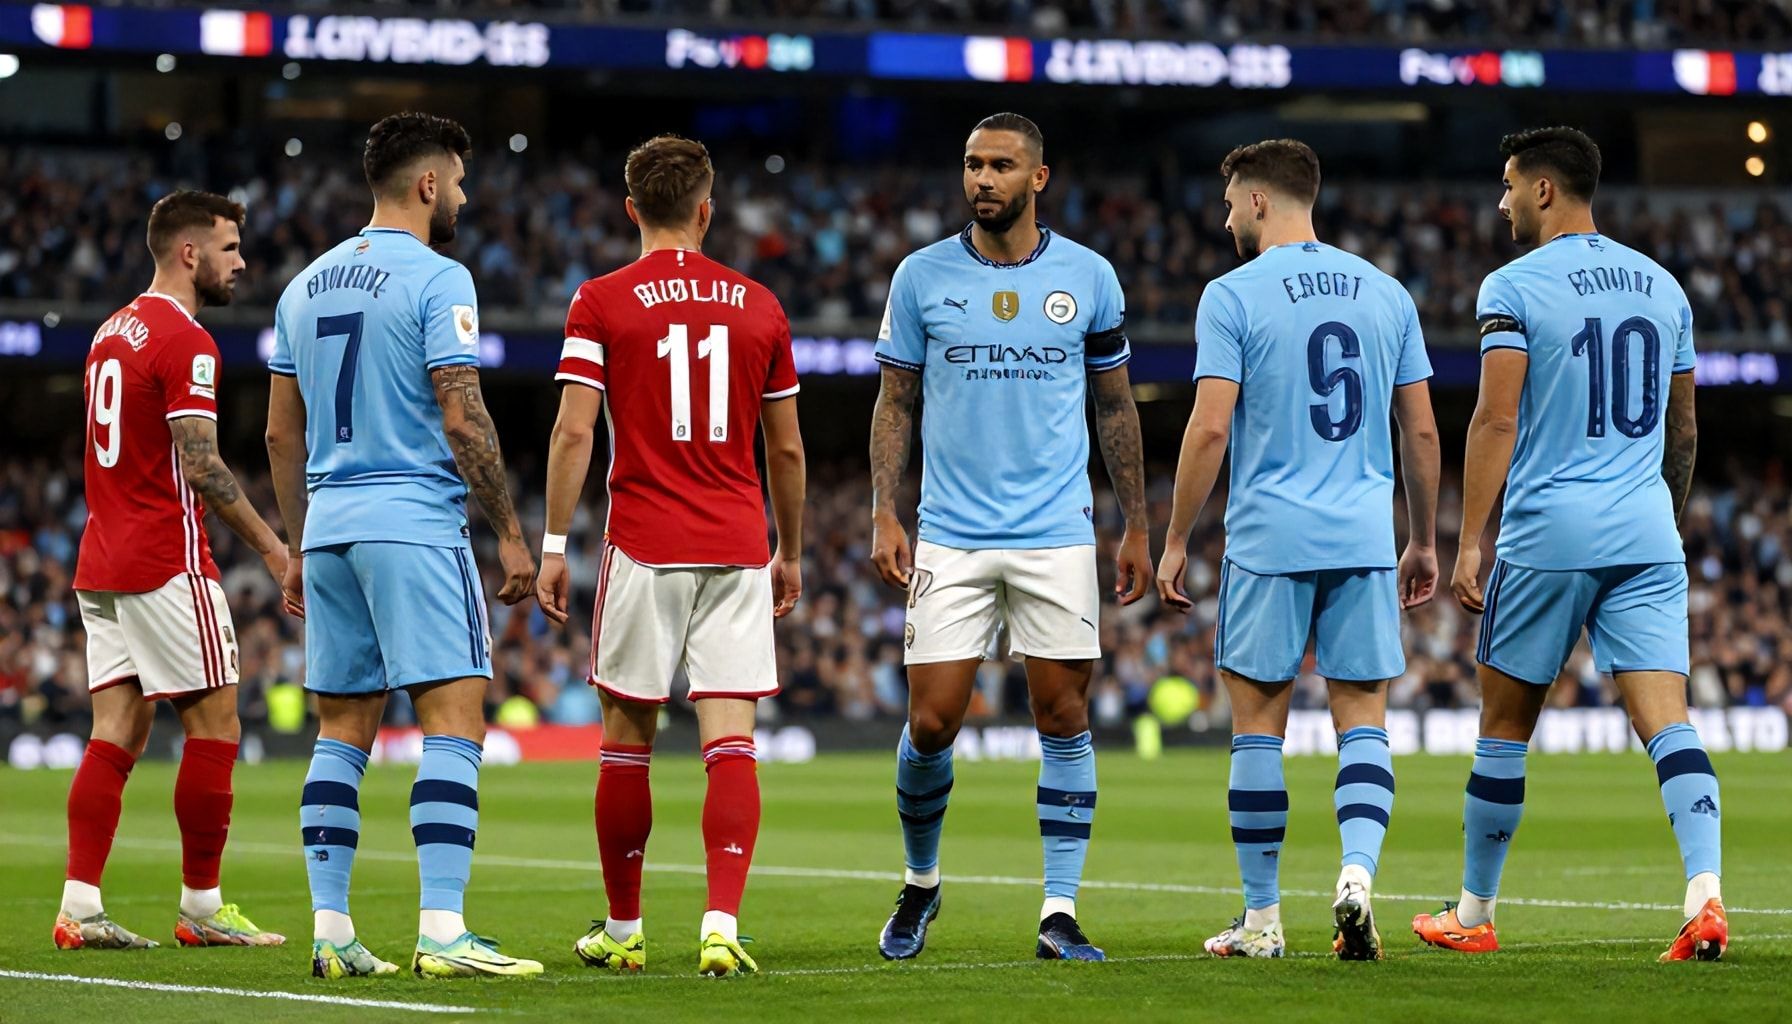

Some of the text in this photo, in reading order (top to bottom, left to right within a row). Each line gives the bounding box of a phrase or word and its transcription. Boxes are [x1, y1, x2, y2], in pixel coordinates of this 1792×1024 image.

[86, 358, 122, 468] 19
[316, 311, 364, 443] 7
[657, 323, 729, 442] 11
[1572, 315, 1660, 439] 10
